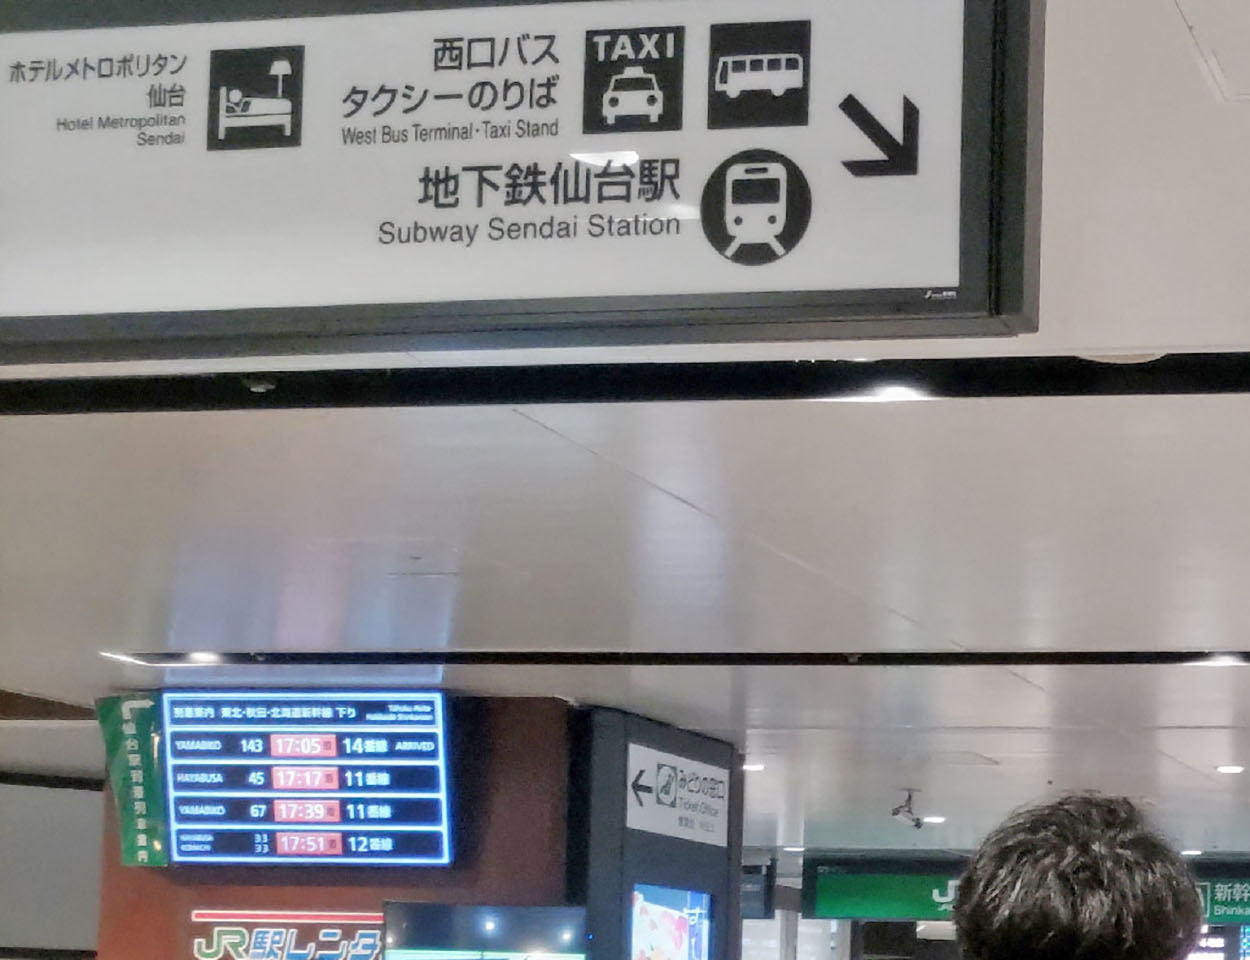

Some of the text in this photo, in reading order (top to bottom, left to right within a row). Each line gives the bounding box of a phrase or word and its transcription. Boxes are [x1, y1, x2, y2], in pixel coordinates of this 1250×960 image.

[433, 33, 560, 72] 西口バス
[593, 33, 675, 61] TAXI
[9, 54, 187, 82] ホテルメトロポリタン
[146, 83, 186, 108] 仙台
[342, 74, 561, 118] タクシーのりば
[57, 114, 186, 132] Hotel Metropolitan
[341, 127, 377, 145] West
[382, 125, 408, 143] Bus
[515, 119, 559, 138] Stand
[137, 132, 185, 147] Sendai
[418, 158, 680, 208] 地下鉄仙台駅
[378, 213, 680, 248] Subway Sendai Station
[240, 739, 263, 752] 143
[248, 772, 264, 785] 45
[250, 805, 267, 818] 67
